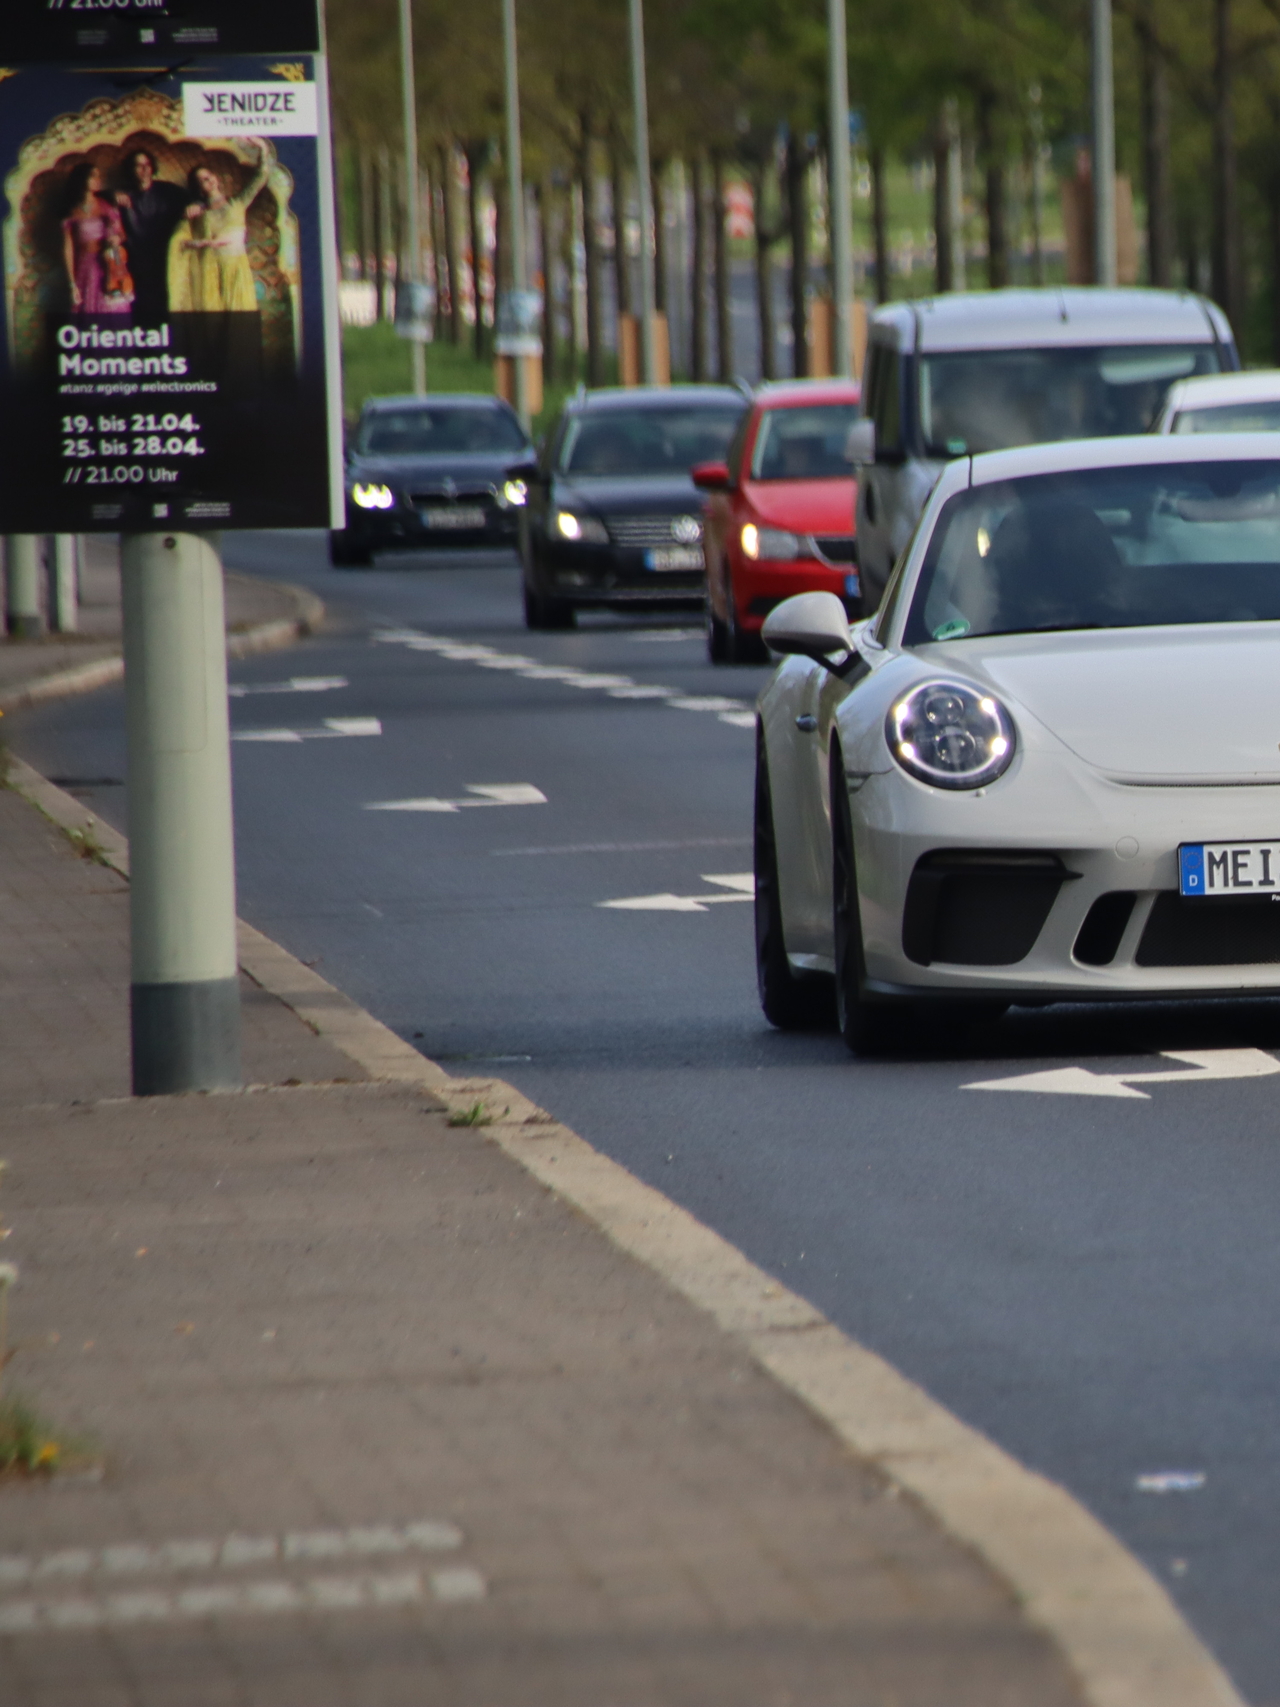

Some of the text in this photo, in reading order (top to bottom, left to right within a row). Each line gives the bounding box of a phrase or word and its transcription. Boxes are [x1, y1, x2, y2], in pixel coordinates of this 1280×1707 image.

[58, 324, 169, 348] Oriental
[59, 354, 187, 376] Moments
[62, 413, 200, 433] 19. bis 21.04.
[63, 436, 205, 457] 25. bis 28.04.
[85, 466, 144, 483] 21.00
[149, 468, 178, 482] Uhr
[1207, 849, 1275, 887] MEI
